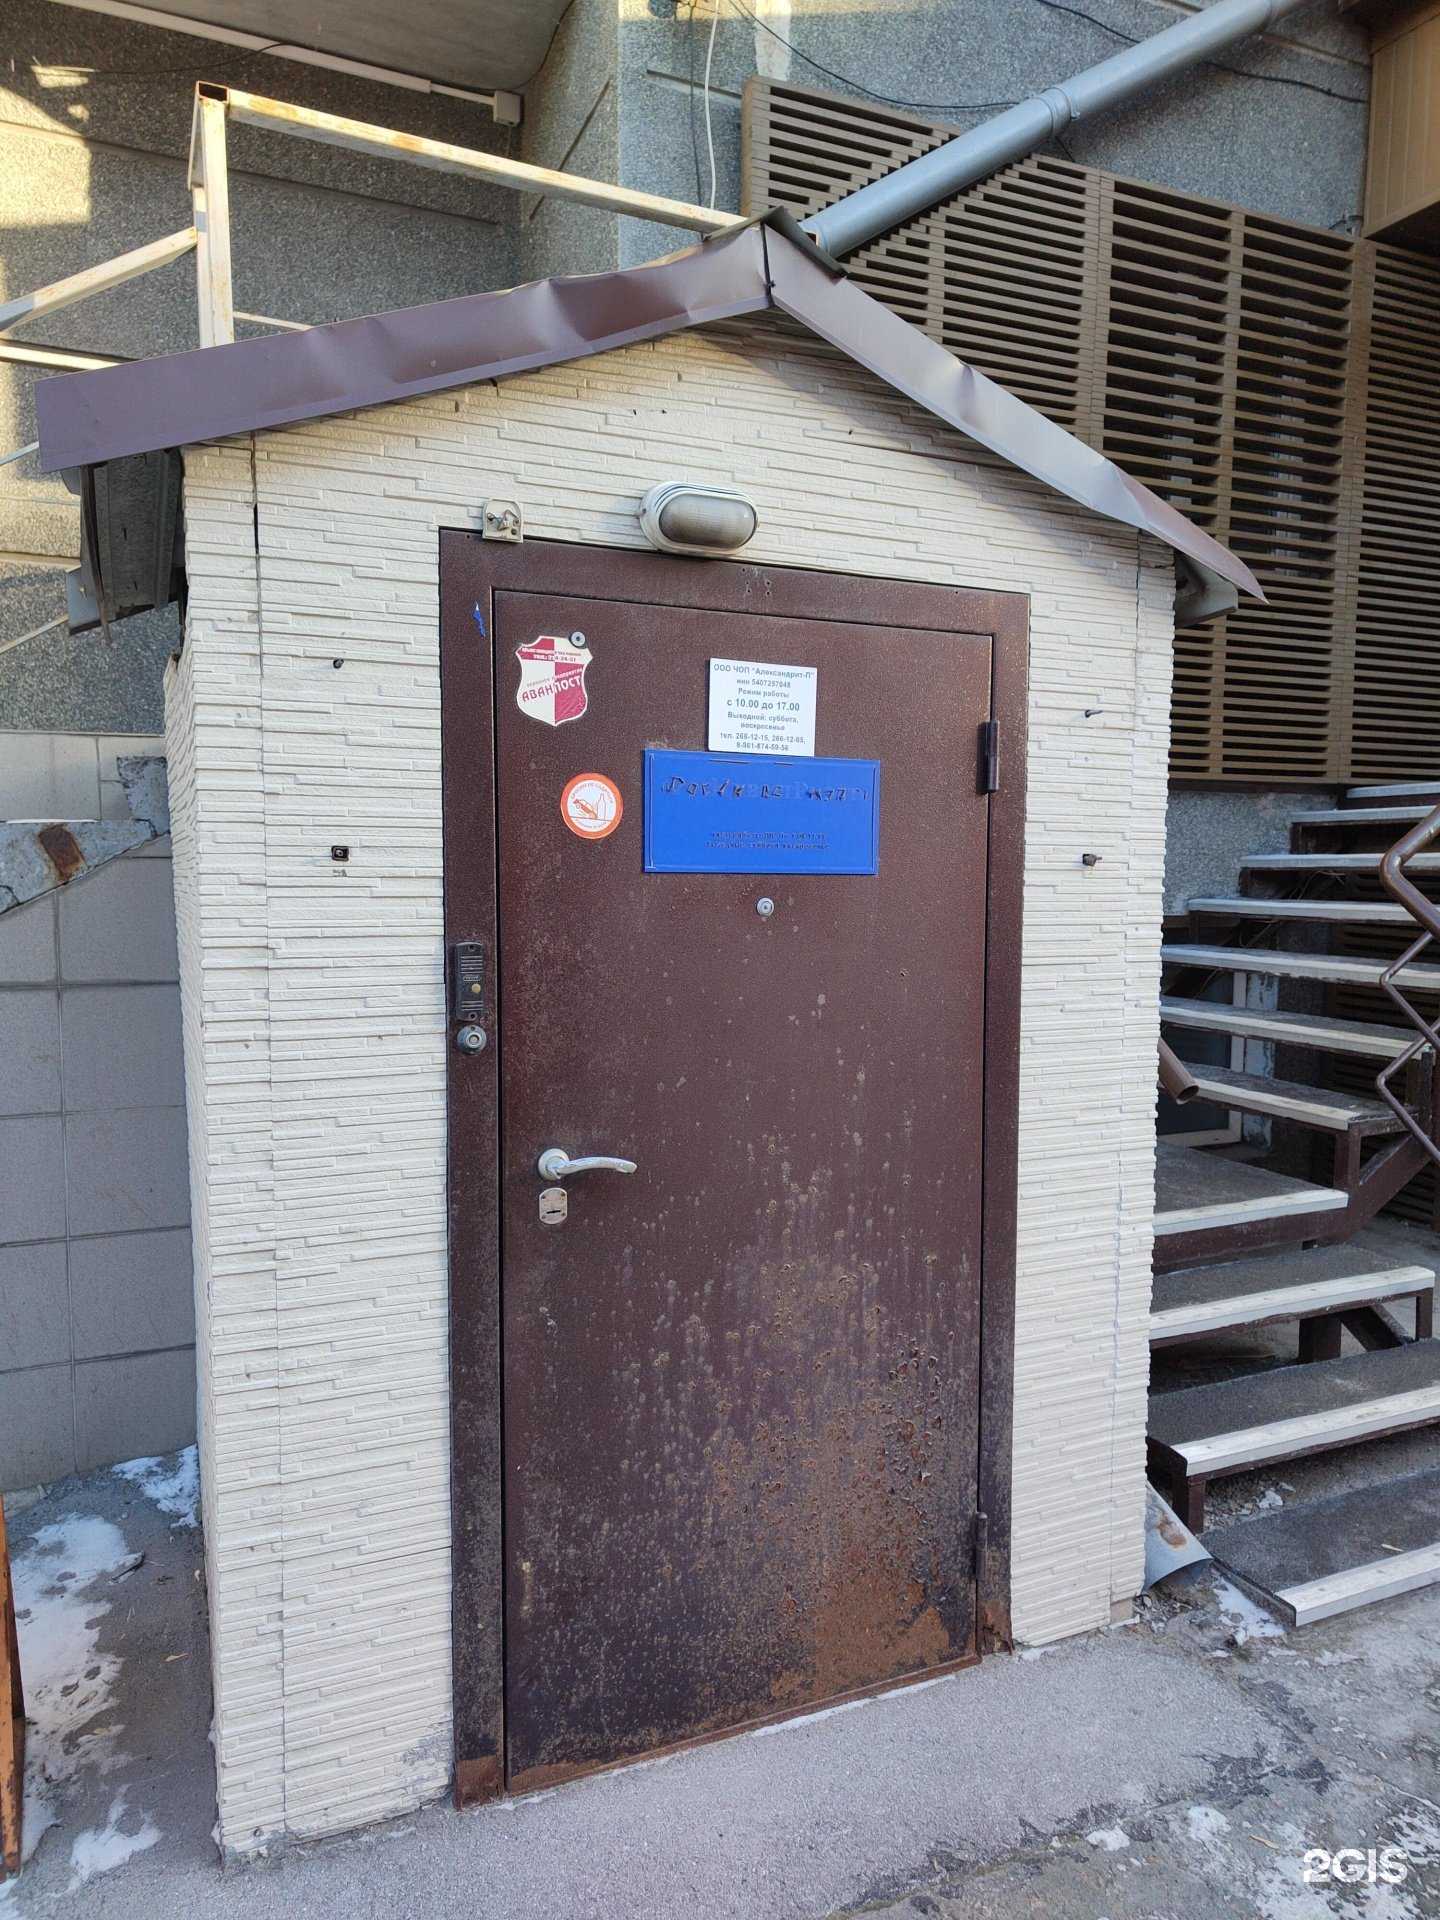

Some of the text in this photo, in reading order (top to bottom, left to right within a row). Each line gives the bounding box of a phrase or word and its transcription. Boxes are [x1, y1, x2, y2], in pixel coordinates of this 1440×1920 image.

[713, 663, 731, 672] ООО
[733, 665, 750, 675] ЧОП
[522, 675, 581, 702] АВАНПОСТ
[738, 687, 761, 695] Режим
[735, 698, 759, 708] 10.00
[777, 701, 800, 712] 17.00
